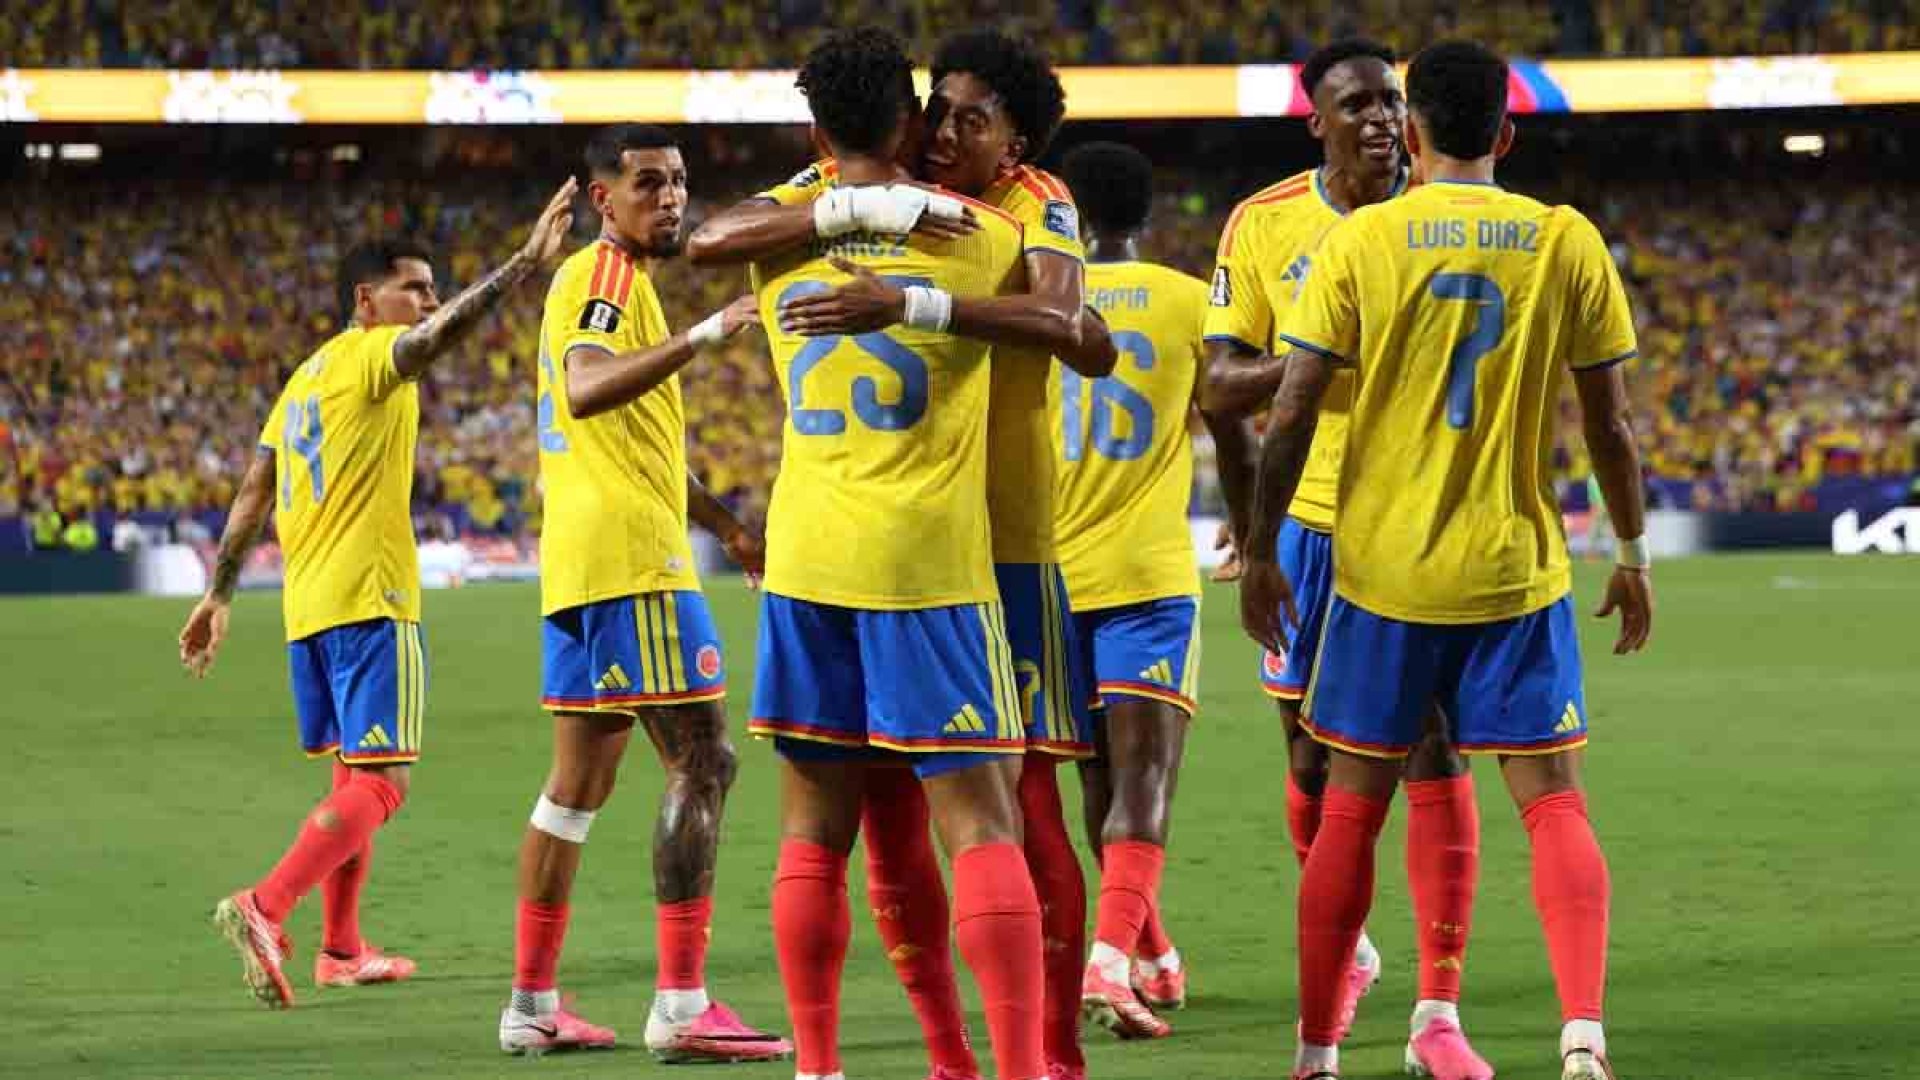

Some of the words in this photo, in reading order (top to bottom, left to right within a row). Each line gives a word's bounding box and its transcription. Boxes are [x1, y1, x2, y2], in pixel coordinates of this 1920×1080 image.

[1408, 219, 1466, 249] LUIS
[776, 275, 935, 435] 25
[1061, 331, 1155, 461] 16
[1431, 273, 1505, 428] 7
[283, 394, 324, 511] 14
